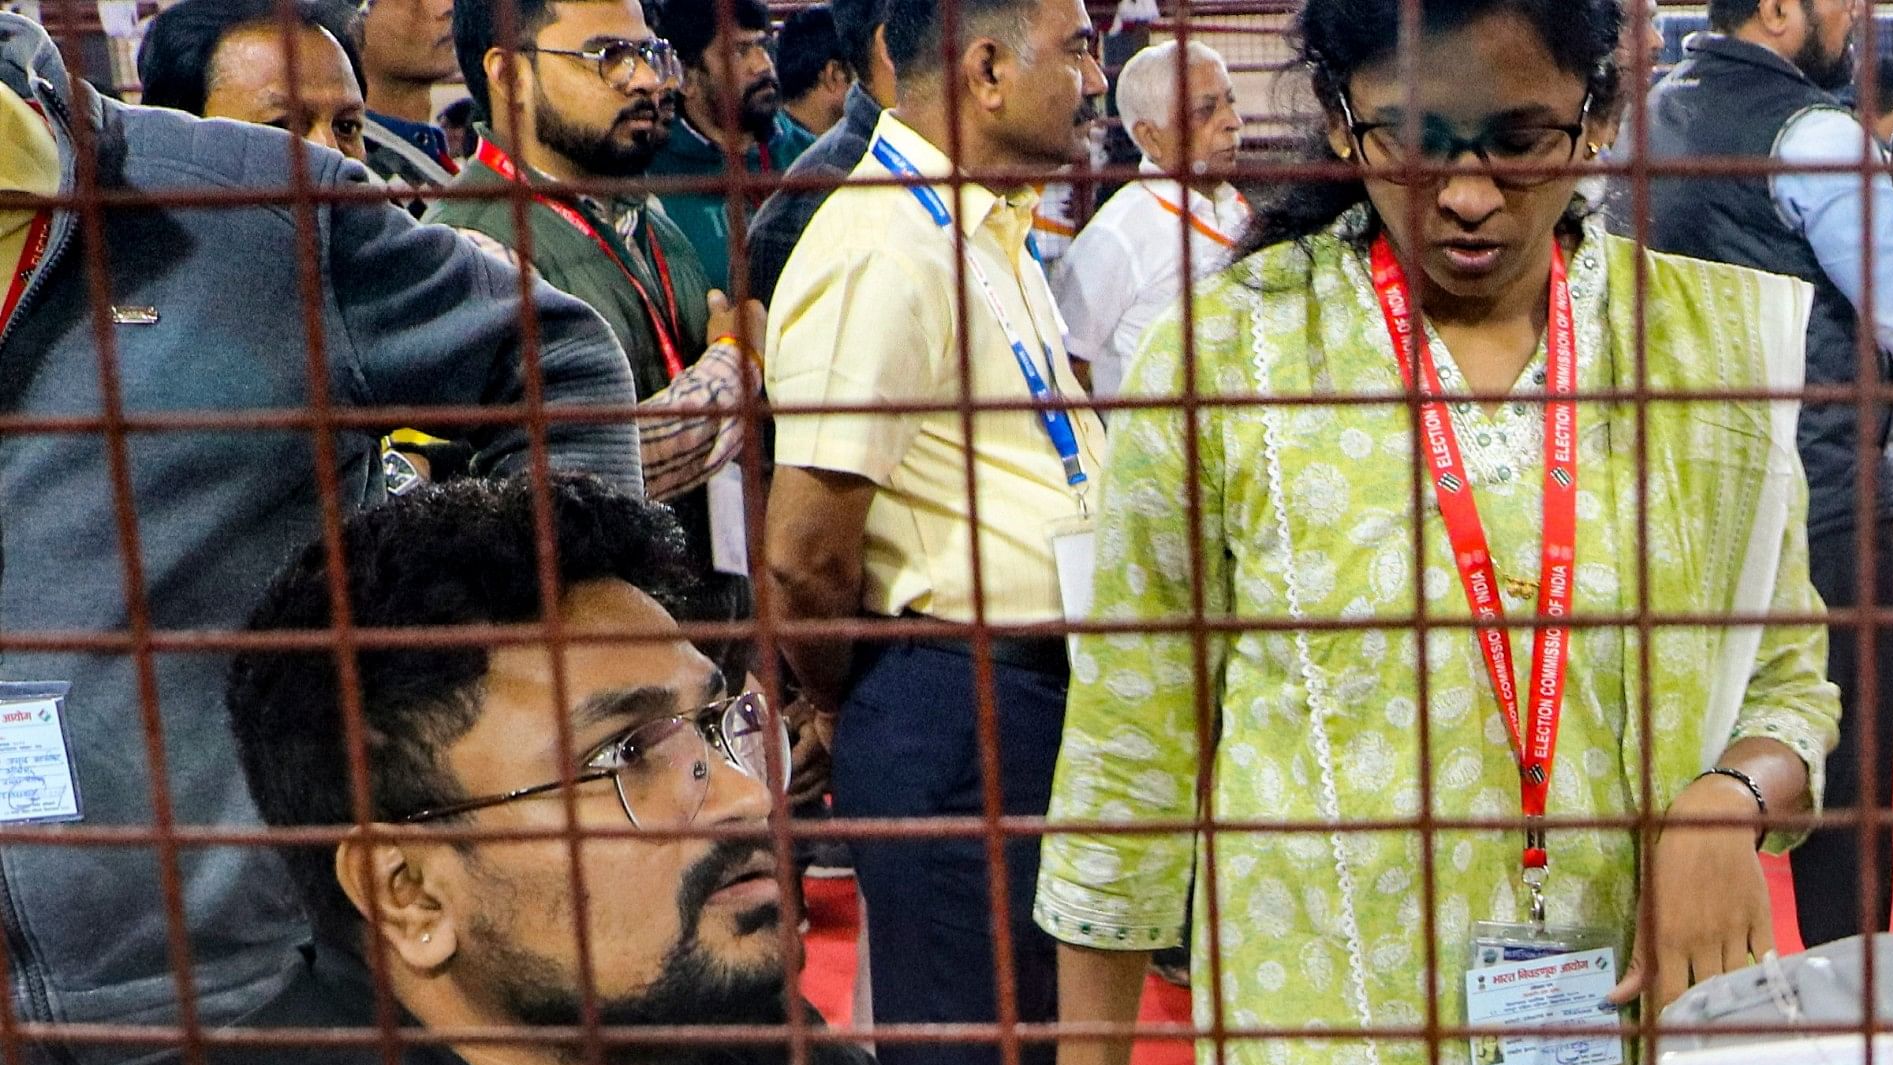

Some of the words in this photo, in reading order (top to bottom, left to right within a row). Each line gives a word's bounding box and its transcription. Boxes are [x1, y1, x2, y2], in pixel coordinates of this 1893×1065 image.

[1386, 287, 1411, 318] INDIA
[1556, 281, 1569, 310] INDIA
[1557, 313, 1570, 329] OF
[1555, 329, 1573, 401] OMMISSION
[1423, 406, 1453, 470] ELECTION
[1554, 404, 1570, 463] ELECTION
[1469, 569, 1491, 606] INDIA
[1551, 565, 1568, 599] INDIA
[1548, 601, 1564, 618] OF
[1541, 627, 1562, 697] COMMISSIO
[1534, 701, 1554, 759] ELECTION
[1492, 972, 1516, 984] भारत
